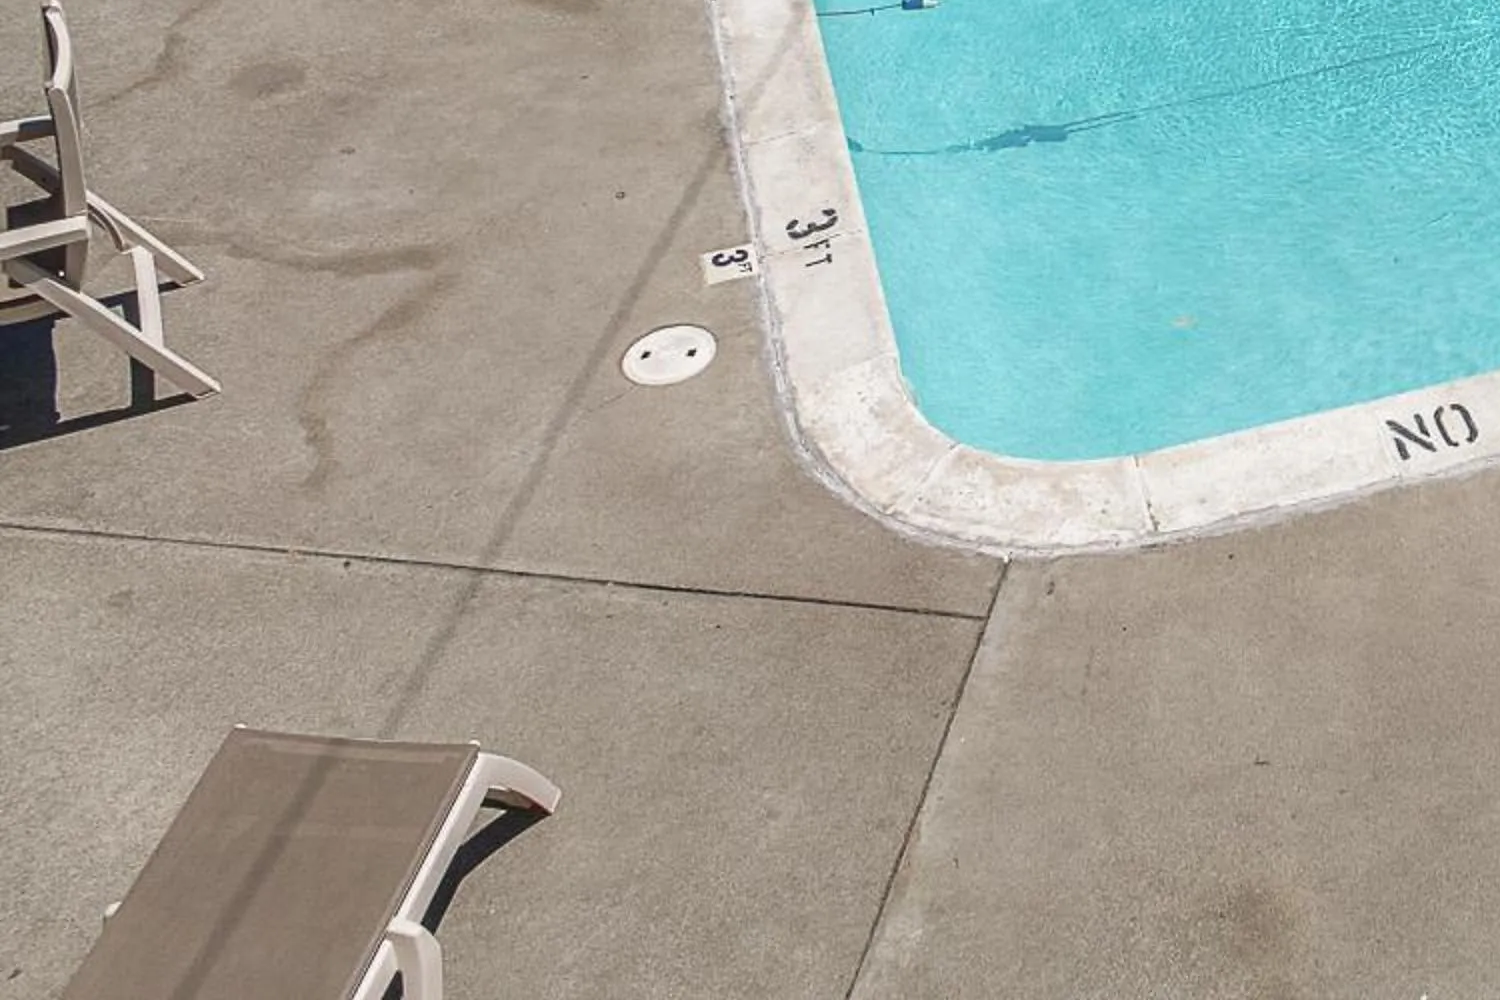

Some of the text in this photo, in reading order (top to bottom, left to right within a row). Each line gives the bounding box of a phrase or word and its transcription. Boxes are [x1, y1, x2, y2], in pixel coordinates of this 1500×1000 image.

[711, 249, 749, 268] 3
[786, 208, 838, 267] 3 FT
[1385, 401, 1481, 461] NO
